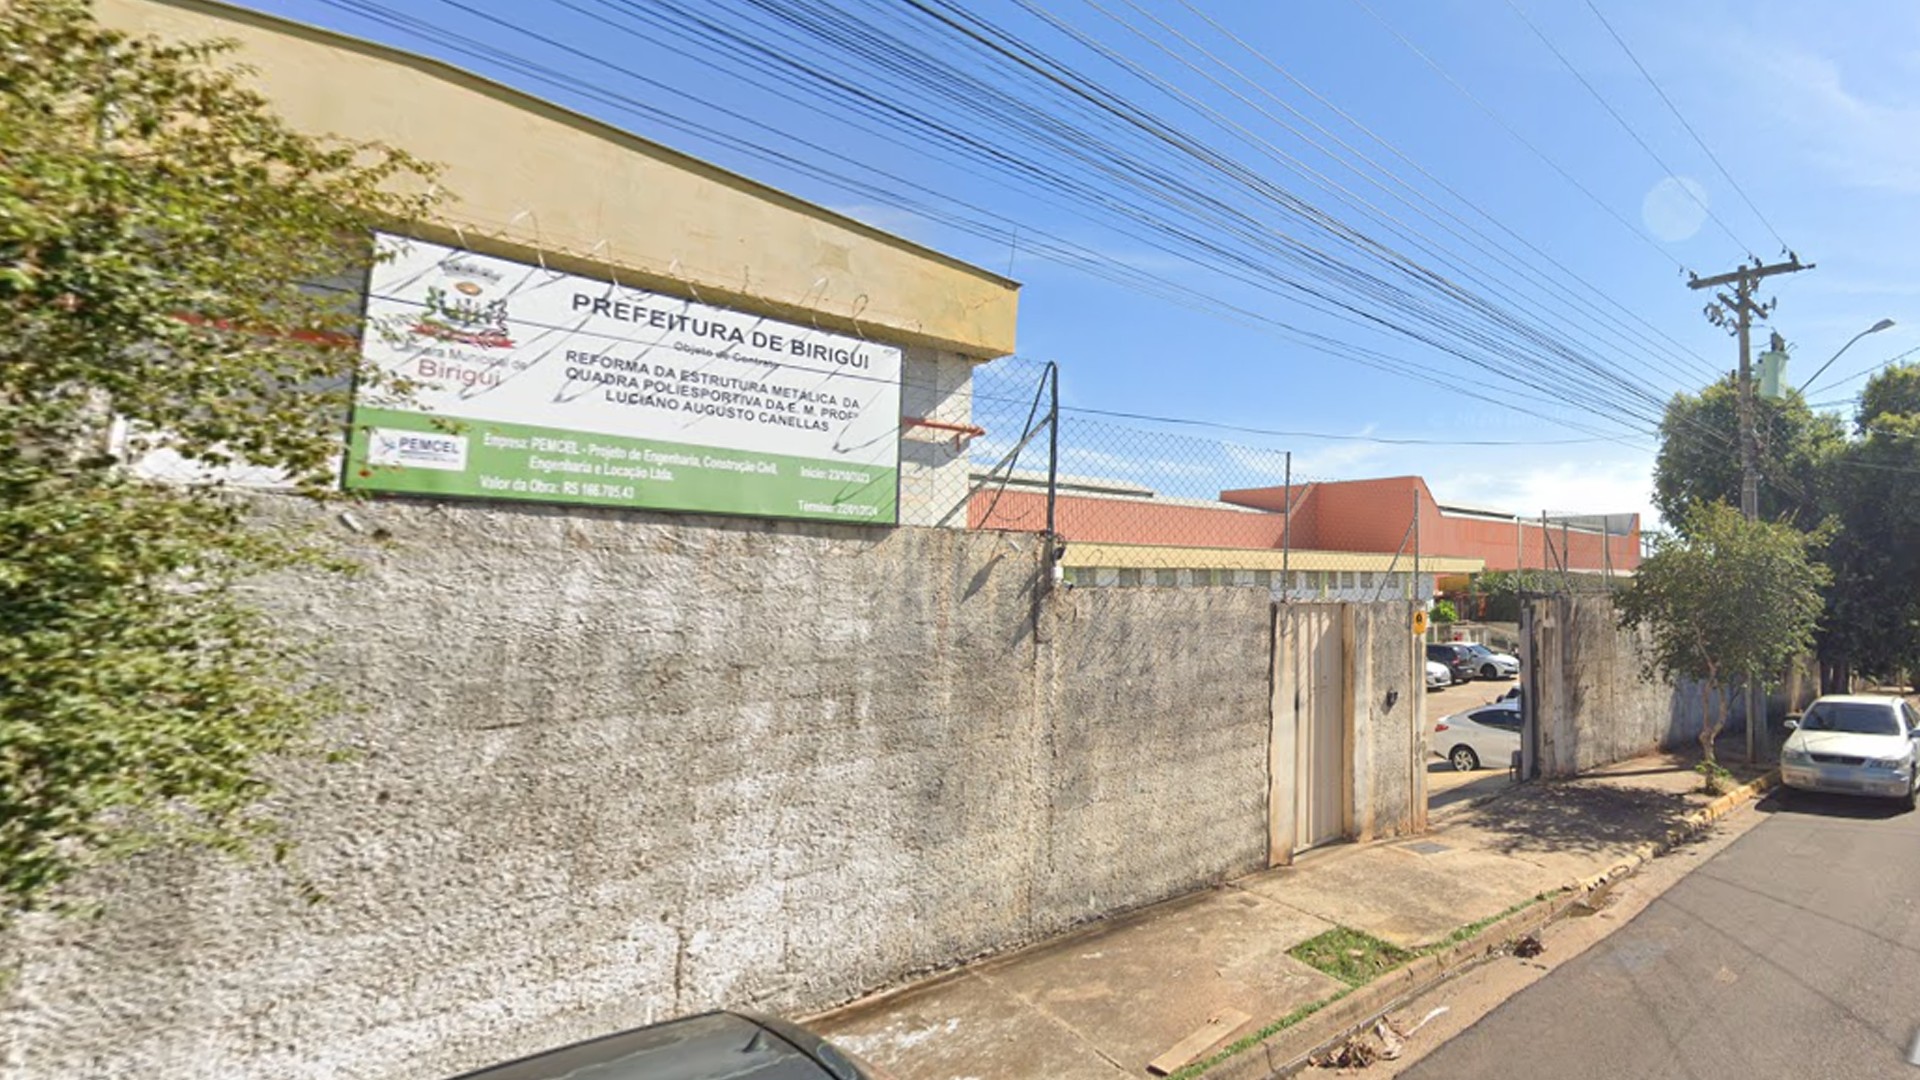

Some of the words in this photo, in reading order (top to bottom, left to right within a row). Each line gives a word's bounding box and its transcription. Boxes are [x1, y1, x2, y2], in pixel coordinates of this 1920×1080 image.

[572, 293, 745, 345] PREFEITURA
[752, 331, 783, 353] DE
[791, 338, 870, 370] BIRIGUI
[673, 340, 714, 357] Objeto
[417, 358, 501, 388] Birigui
[565, 350, 650, 376] REFORMA
[653, 365, 677, 379] DA
[680, 368, 769, 396] ESTRUTURA
[842, 396, 861, 411] DA
[565, 366, 640, 390] QUADRA
[642, 379, 762, 408] POLIESPORTIVA
[765, 398, 785, 412] DA
[605, 389, 679, 411] LUCIANO
[681, 400, 755, 422] AUGUSTO
[758, 411, 829, 433] CANELLAS
[399, 436, 459, 455] PEMCEL
[530, 436, 579, 455] PEMCEL
[628, 448, 642, 461] de
[479, 473, 511, 491] Valor
[512, 477, 527, 492] da
